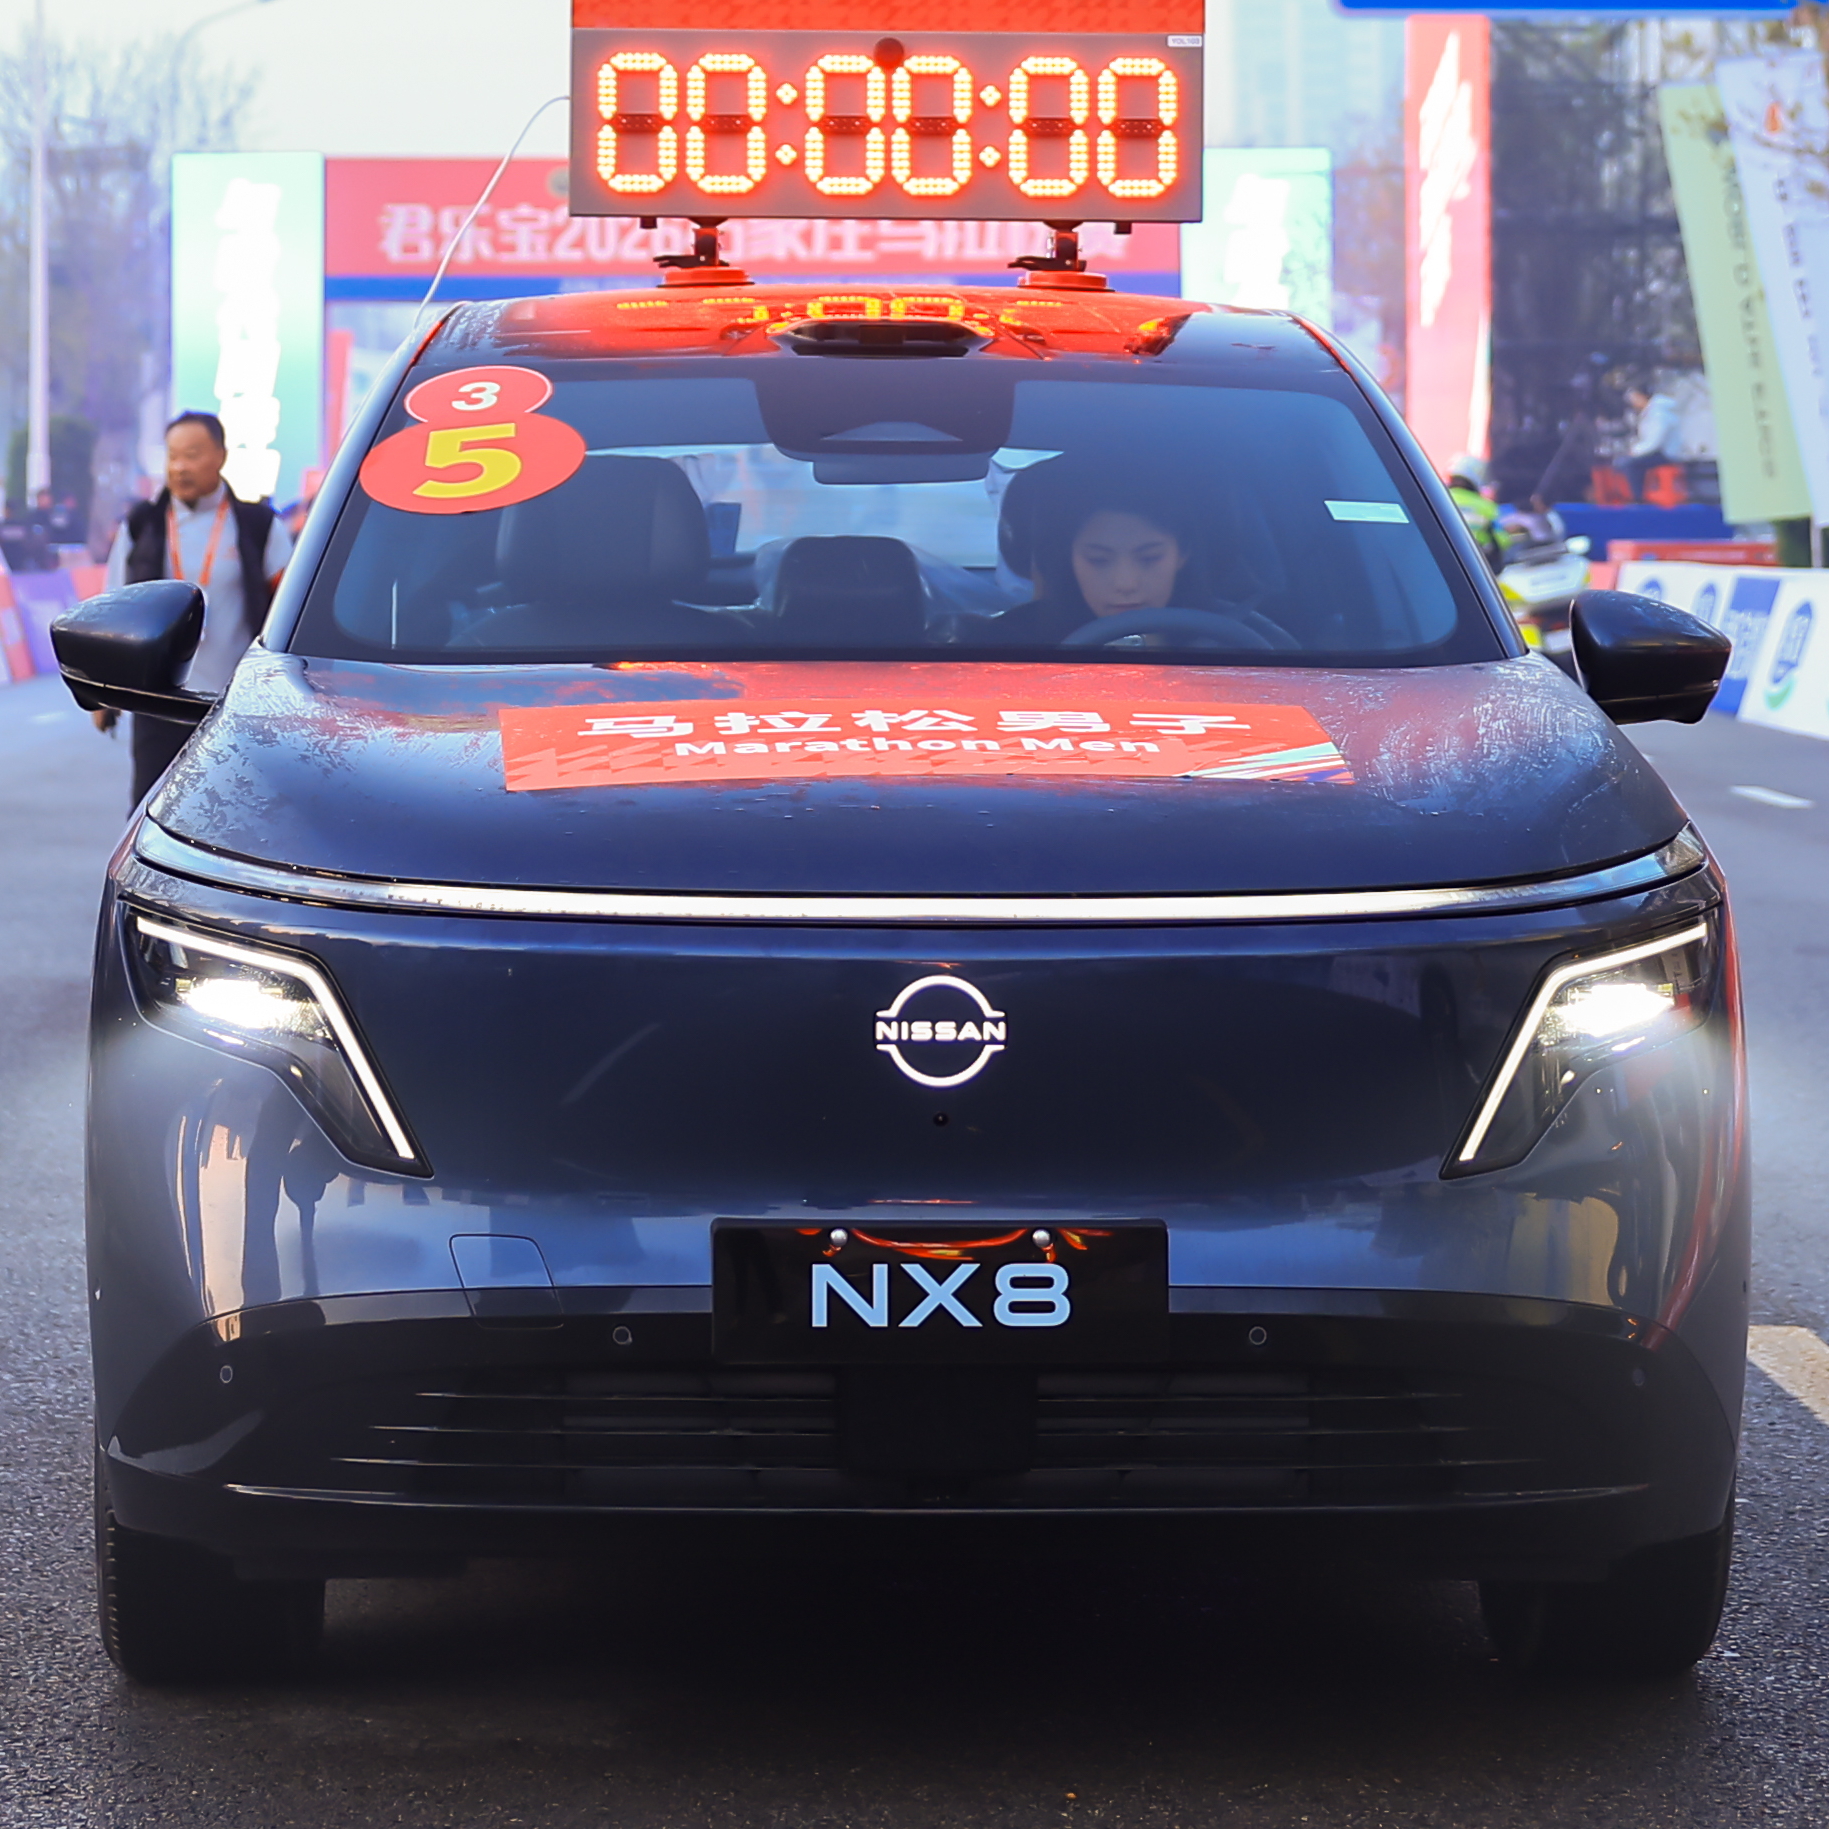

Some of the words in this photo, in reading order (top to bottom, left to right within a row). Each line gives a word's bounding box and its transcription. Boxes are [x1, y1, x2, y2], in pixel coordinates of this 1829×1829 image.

[597, 52, 1178, 198] 00:00:00
[451, 382, 501, 411] 3
[412, 423, 522, 499] 5
[578, 709, 1250, 739] 马拉松男子
[675, 737, 999, 757] Marathon
[1022, 737, 1160, 755] Men
[876, 1021, 1006, 1041] NISSAN
[811, 1263, 1071, 1328] NX8
